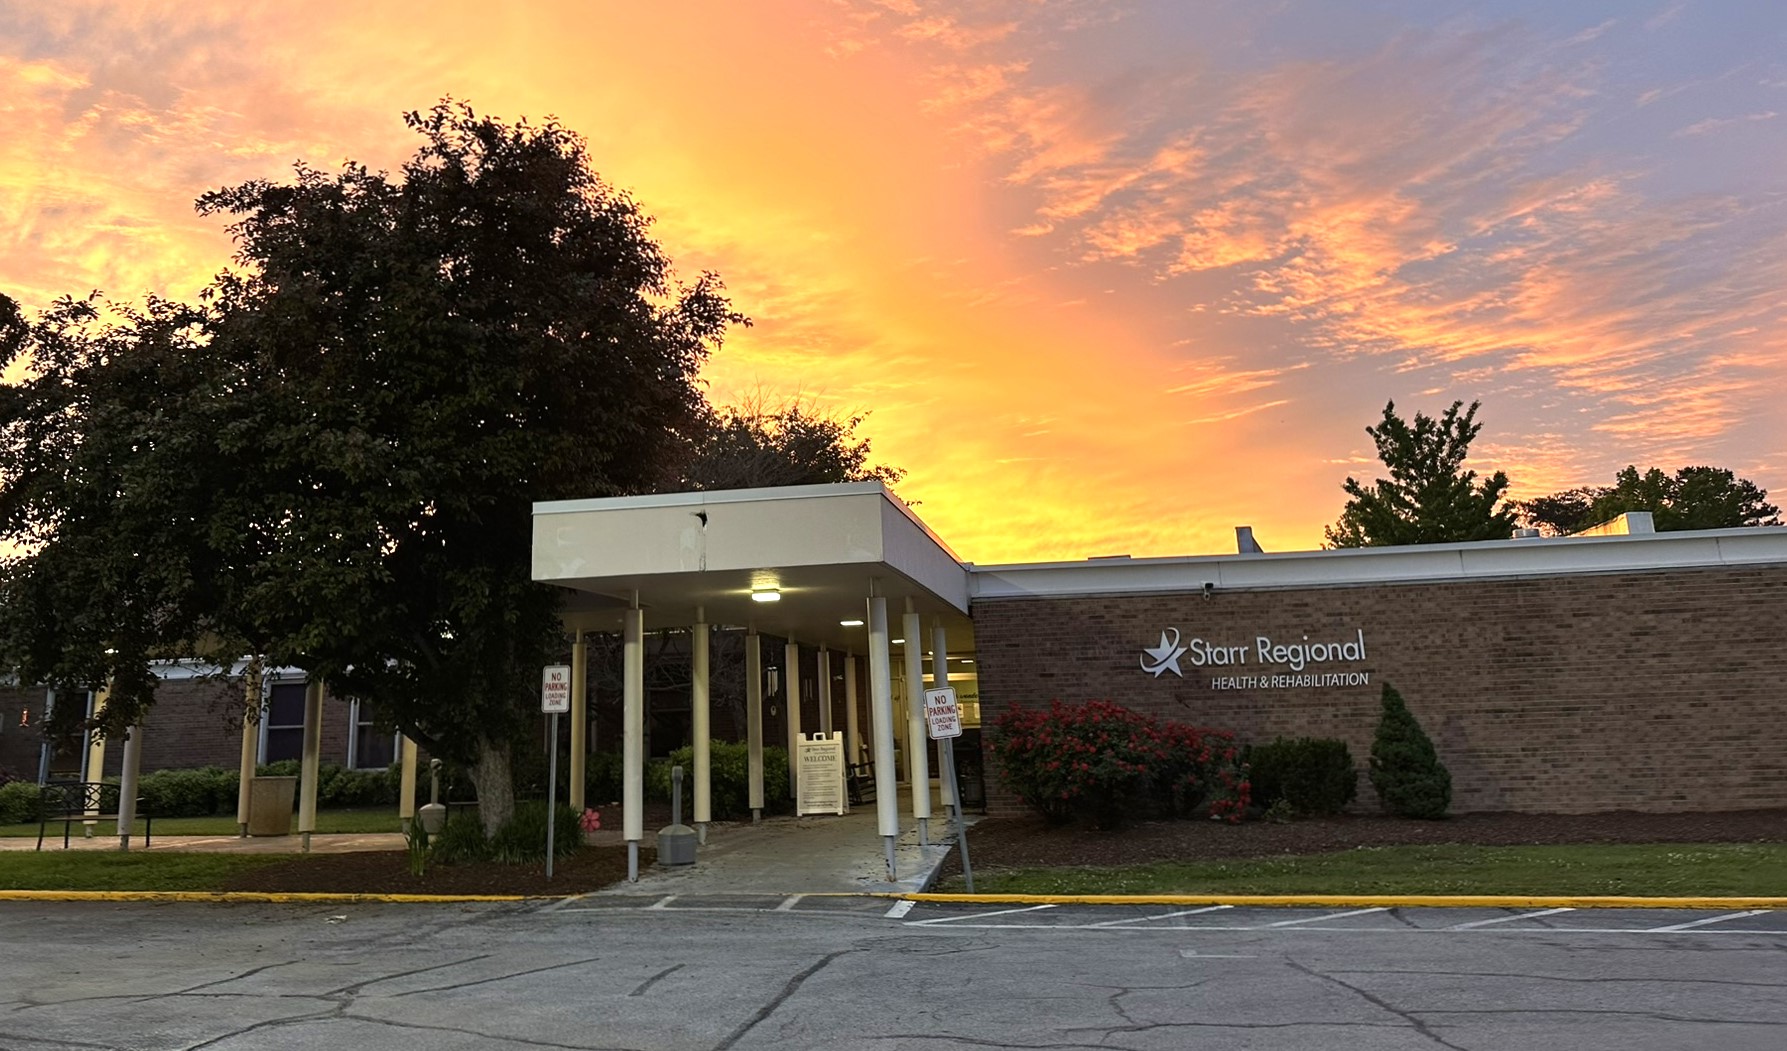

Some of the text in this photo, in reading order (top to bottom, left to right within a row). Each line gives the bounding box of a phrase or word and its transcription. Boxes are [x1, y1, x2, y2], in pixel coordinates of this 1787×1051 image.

[1190, 629, 1366, 671] Starr Regional
[551, 672, 561, 681] NO
[1211, 672, 1369, 690] HEALTH & REHABILITATION
[544, 682, 567, 691] PARKING
[934, 694, 947, 705] NO
[929, 704, 956, 717] PARKING
[931, 715, 957, 726] LOADING
[937, 723, 953, 732] ZONE
